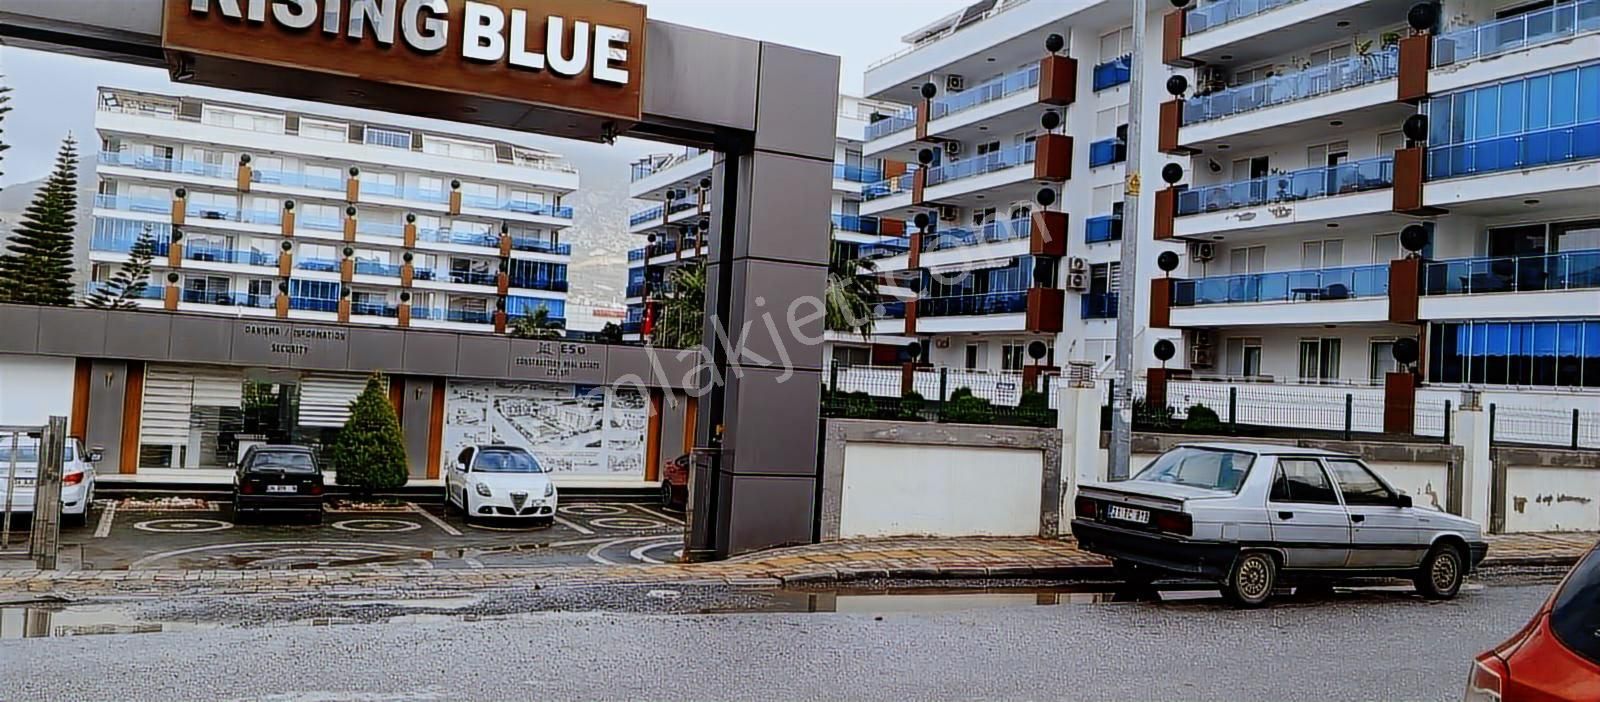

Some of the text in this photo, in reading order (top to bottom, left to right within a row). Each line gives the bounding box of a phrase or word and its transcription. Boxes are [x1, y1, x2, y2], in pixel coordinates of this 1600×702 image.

[190, 0, 630, 84] SING BLUE
[271, 343, 308, 355] SECURITY
